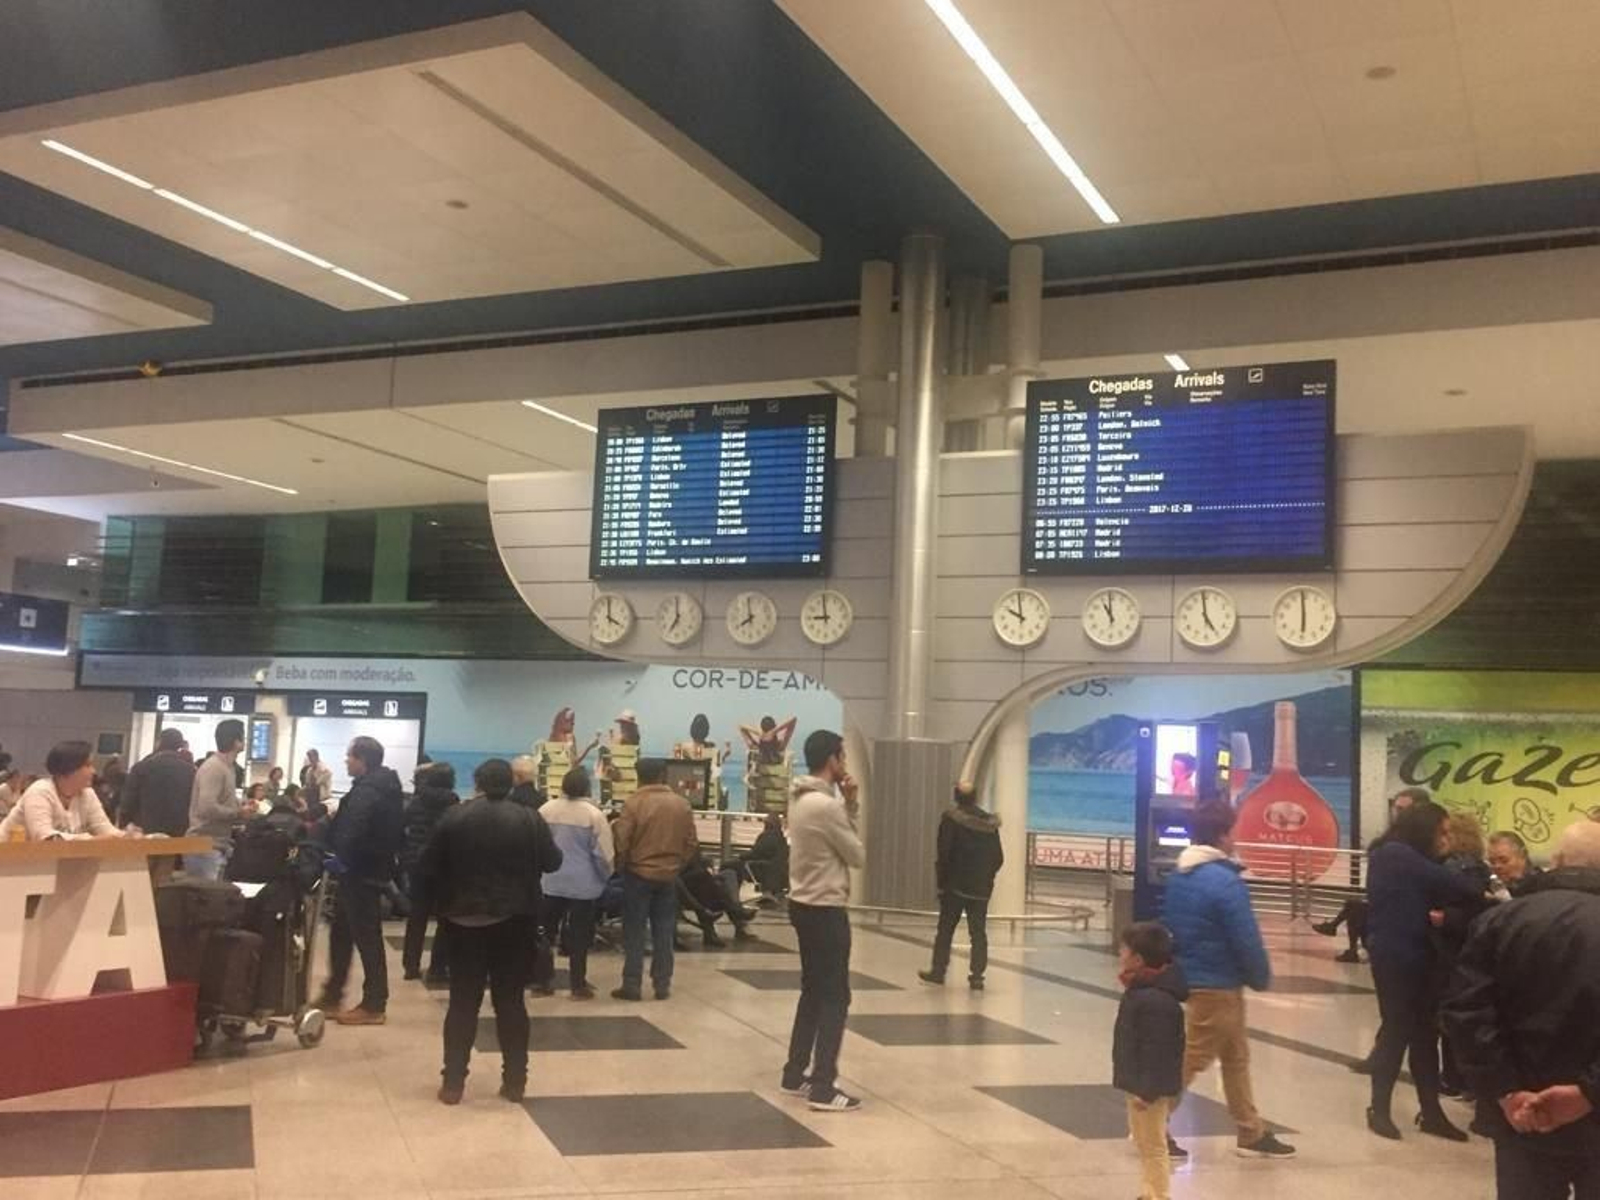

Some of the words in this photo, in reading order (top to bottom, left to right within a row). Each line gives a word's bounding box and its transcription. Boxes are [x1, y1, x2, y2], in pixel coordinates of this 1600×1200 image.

[1088, 377, 1153, 395] Chegadas
[1174, 371, 1225, 388] Arrivals
[645, 408, 696, 421] Chegadas
[712, 403, 750, 416] Arrivals
[275, 664, 307, 680] Beba
[310, 668, 338, 680] com
[340, 665, 417, 684] moderação.
[672, 668, 829, 690] COR-DE-AM
